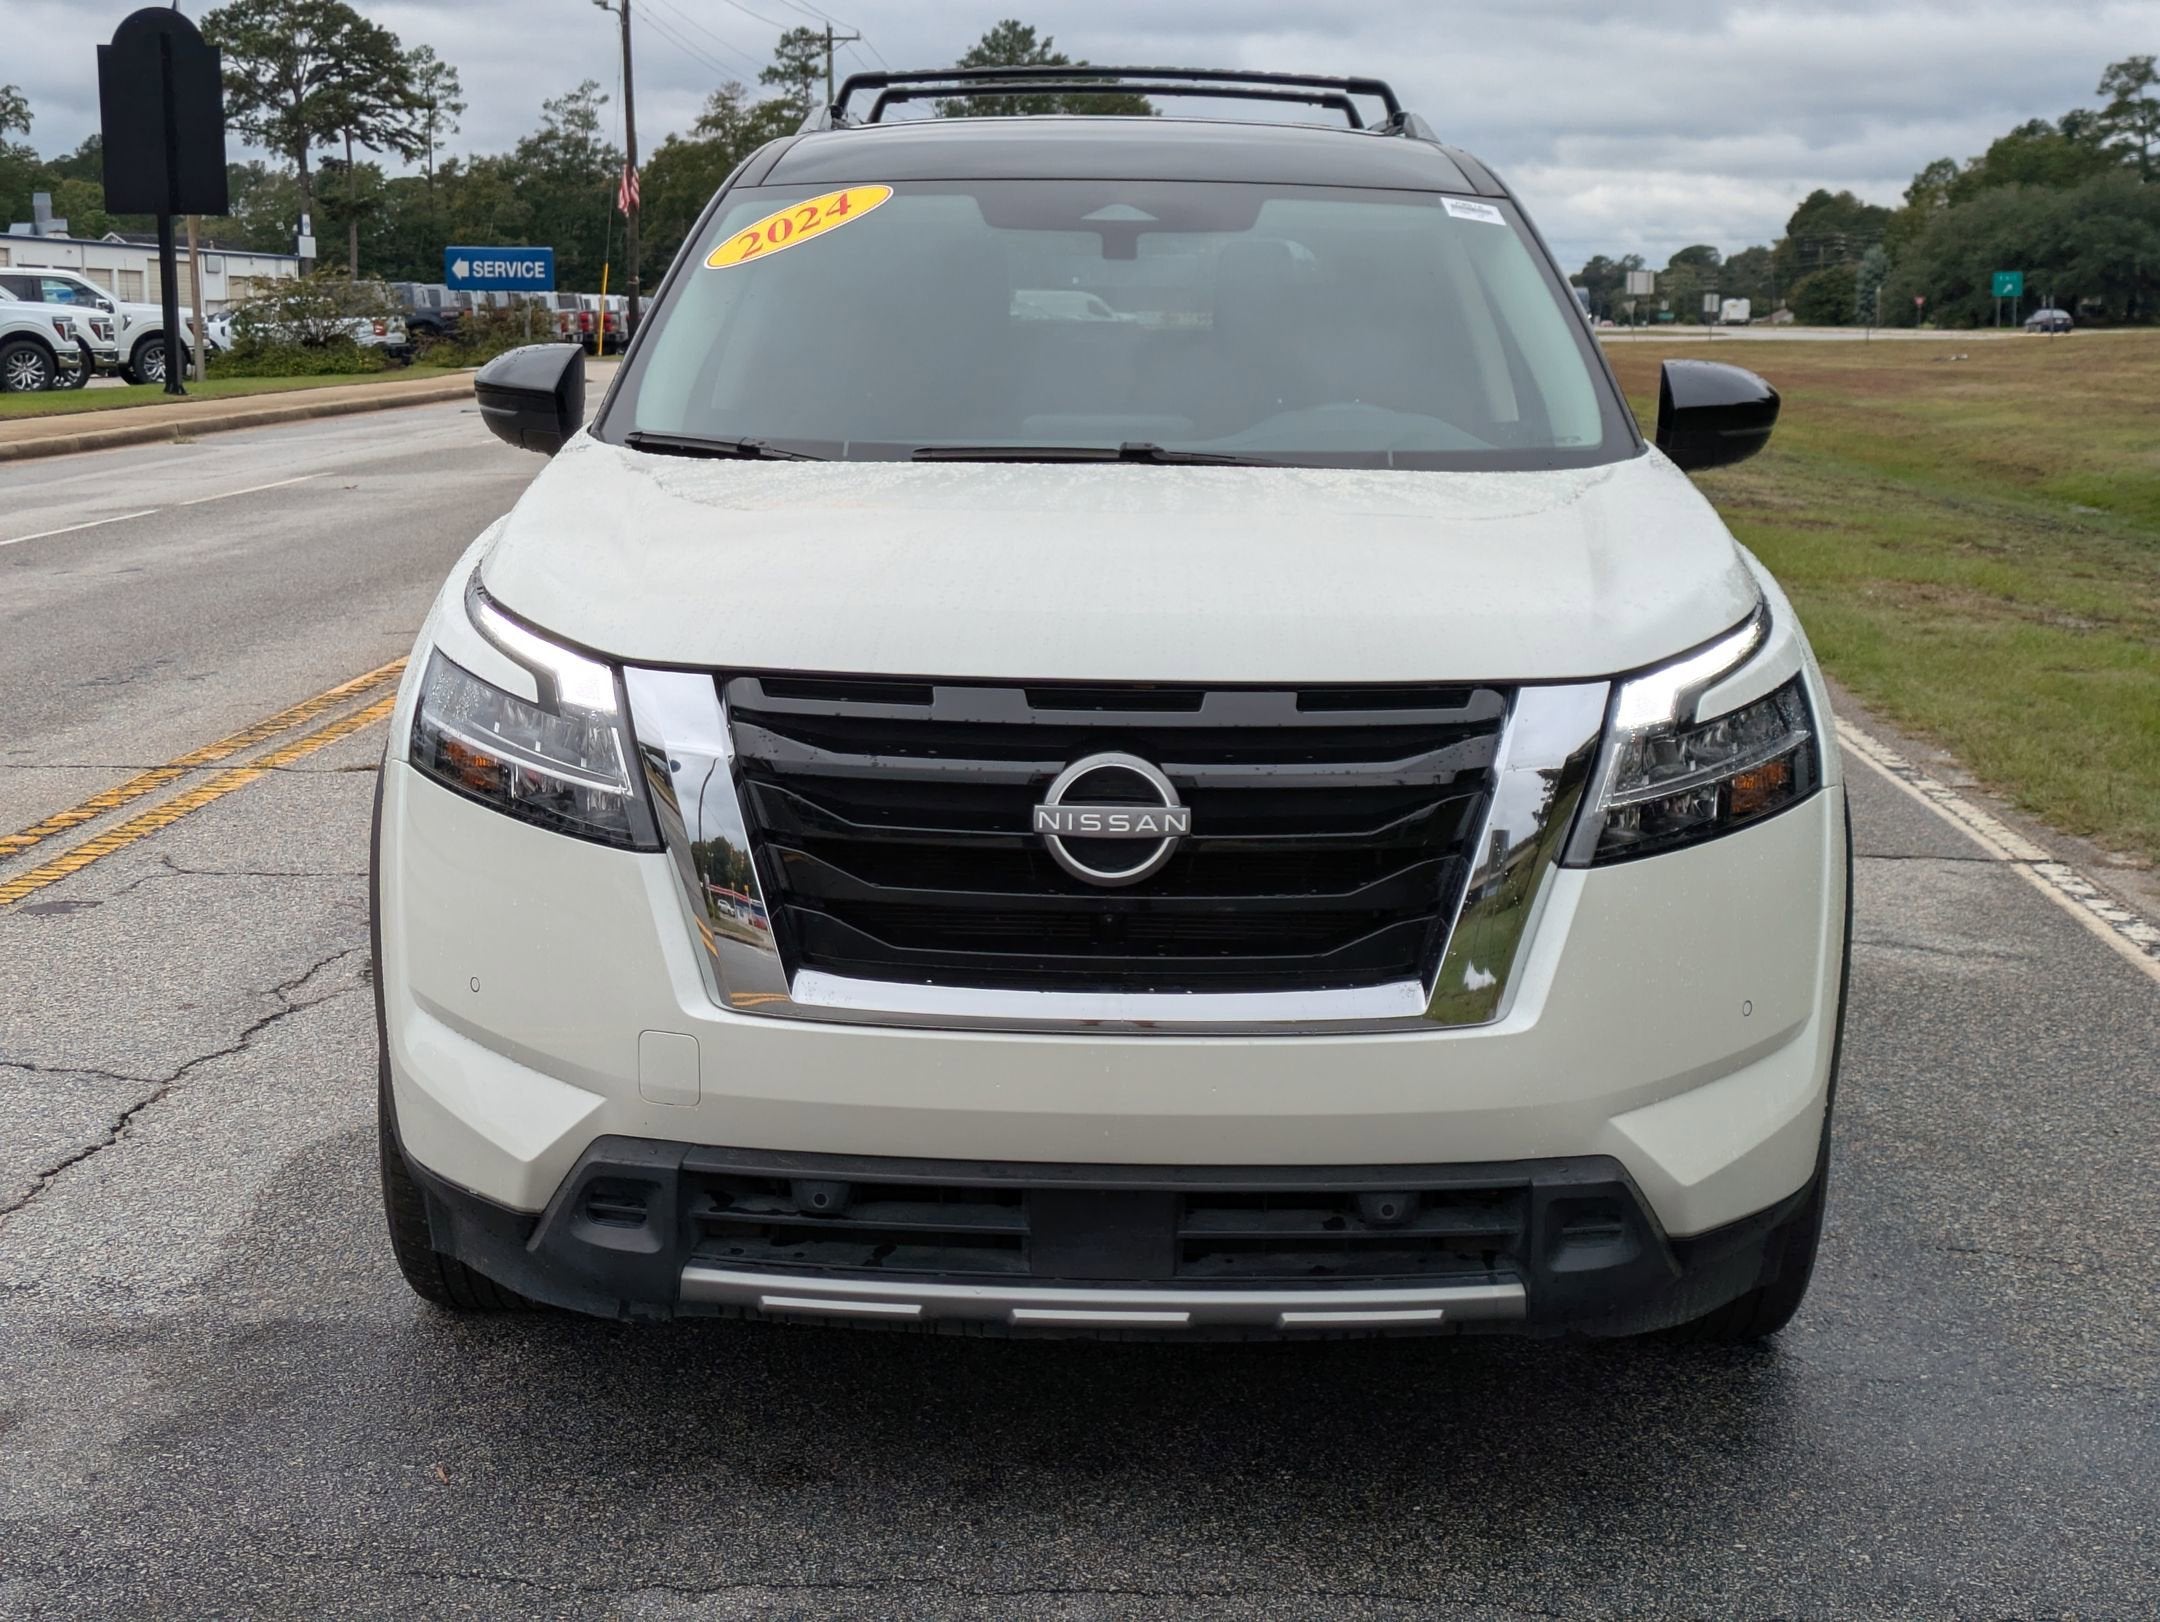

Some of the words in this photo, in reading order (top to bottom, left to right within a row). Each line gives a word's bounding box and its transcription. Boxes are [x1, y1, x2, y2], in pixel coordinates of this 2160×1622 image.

[738, 193, 852, 260] 2024
[472, 261, 546, 278] SERVICE
[1038, 811, 1187, 832] NISSAN
